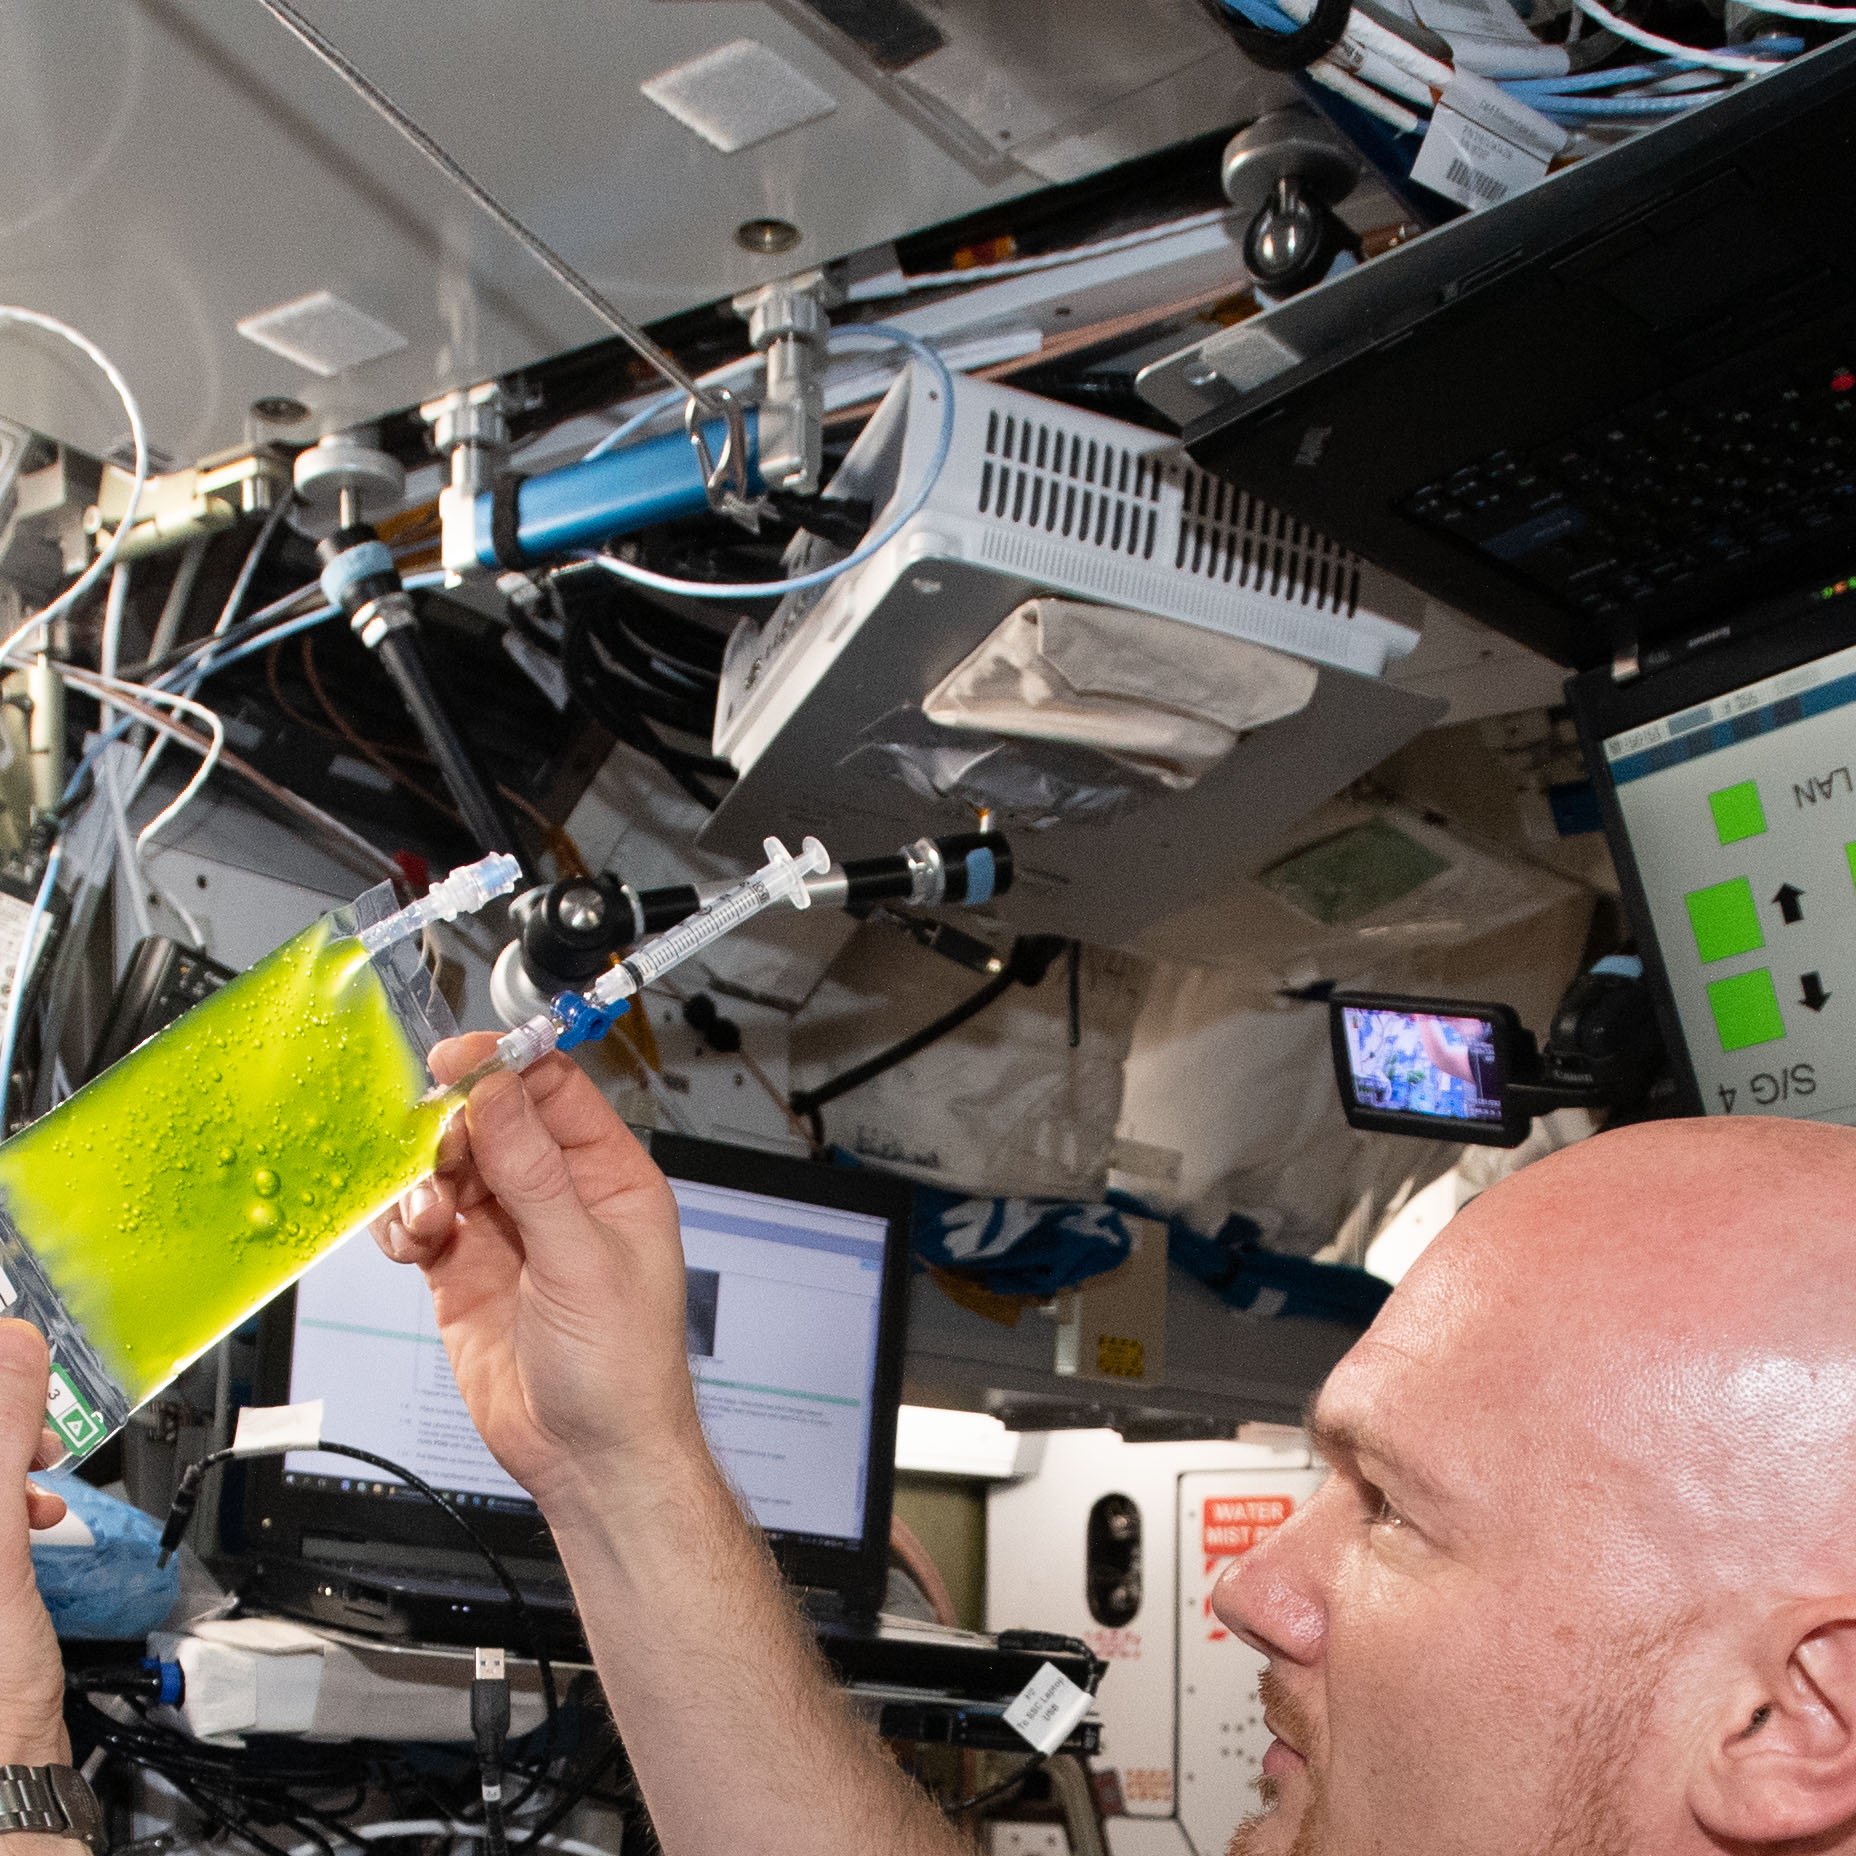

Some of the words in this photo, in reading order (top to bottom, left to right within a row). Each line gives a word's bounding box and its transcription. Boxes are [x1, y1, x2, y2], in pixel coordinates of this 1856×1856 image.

[1791, 766, 1854, 809] LAN
[1716, 1082, 1739, 1113] 4
[1750, 1063, 1818, 1108] S/G
[47, 1387, 61, 1402] 3
[1214, 1502, 1284, 1521] WATER
[1206, 1526, 1254, 1546] MIST
[1039, 1674, 1066, 1704] Laptop
